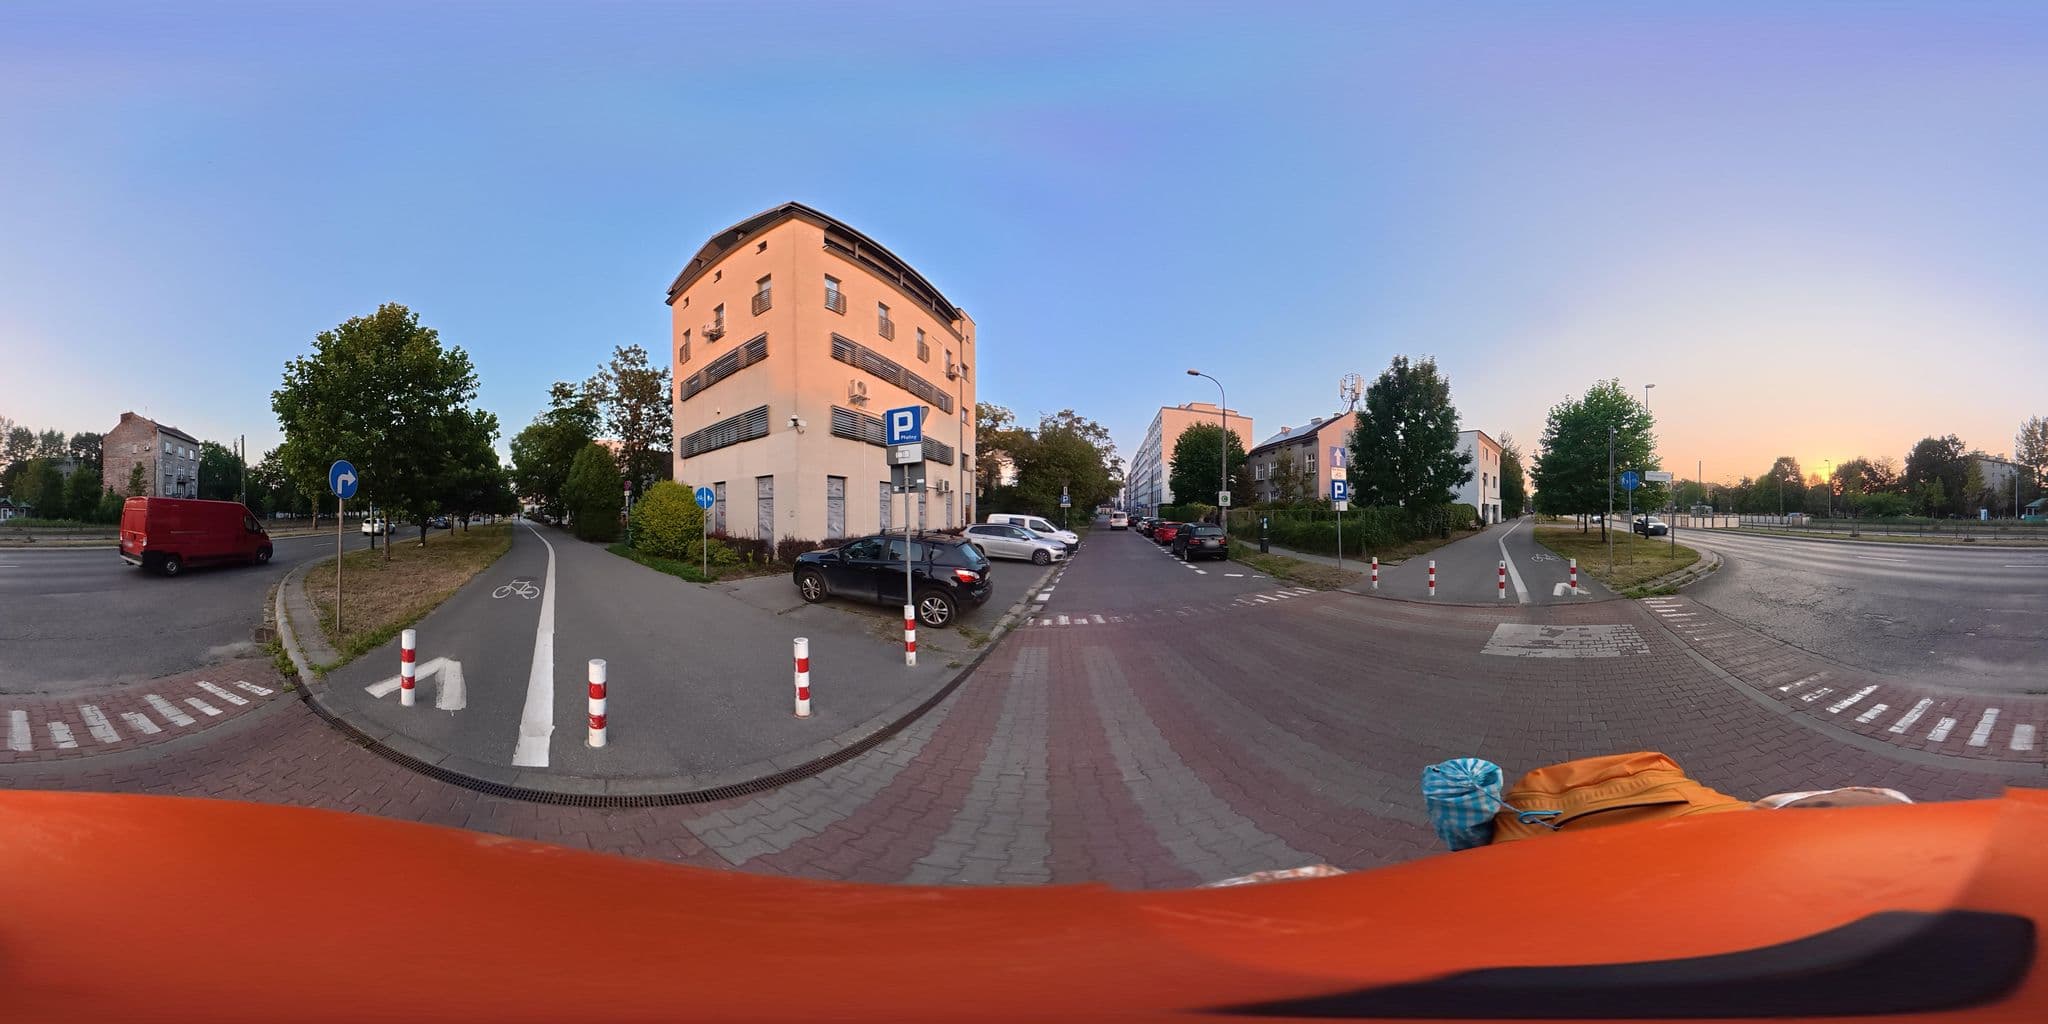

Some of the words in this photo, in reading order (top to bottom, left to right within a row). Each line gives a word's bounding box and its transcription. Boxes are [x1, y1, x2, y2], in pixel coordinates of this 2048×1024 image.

[893, 411, 913, 440] P
[1334, 482, 1343, 498] P
[1062, 495, 1068, 503] P
